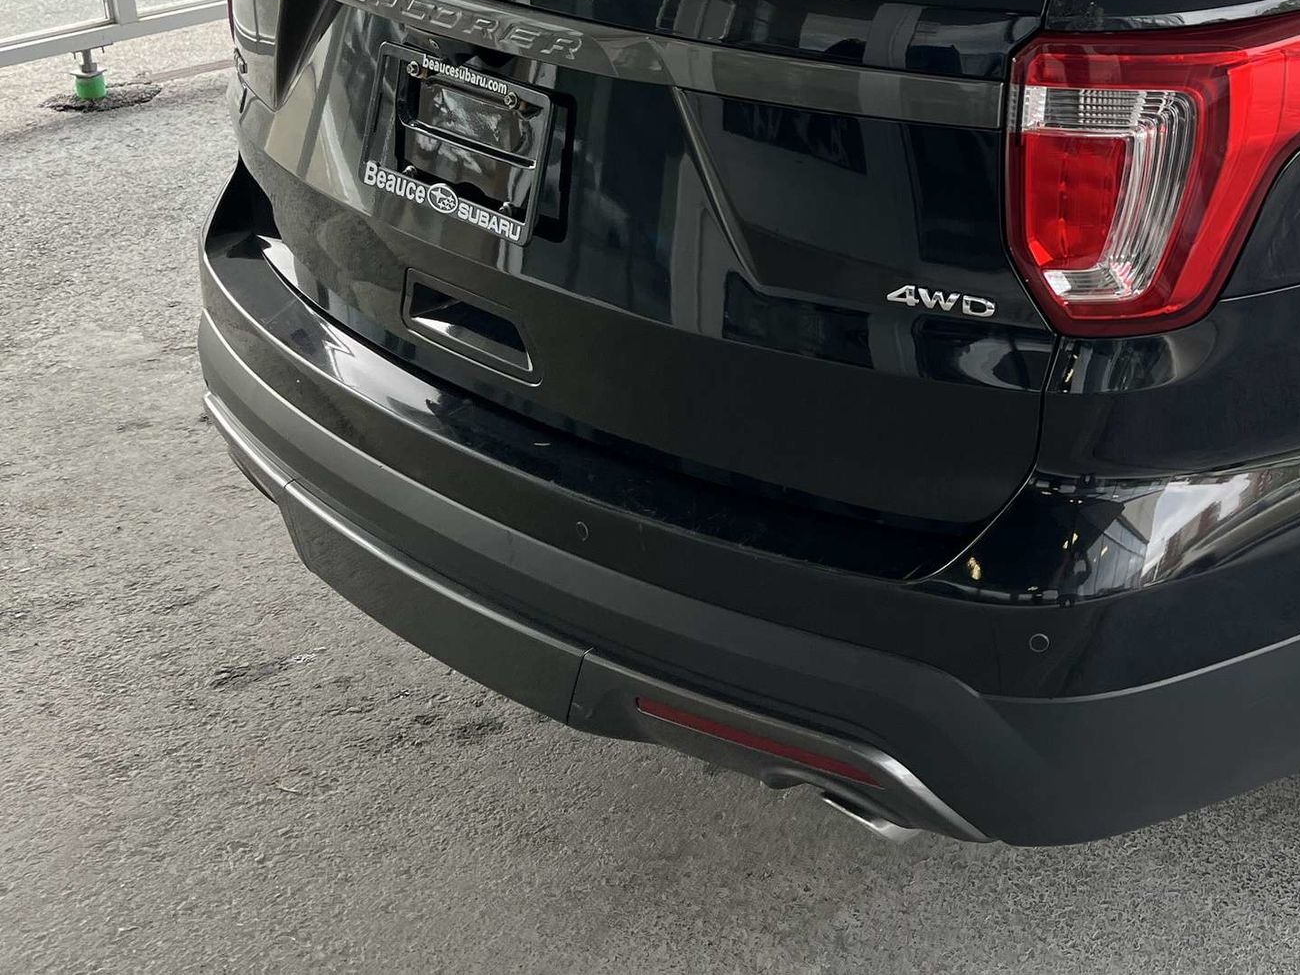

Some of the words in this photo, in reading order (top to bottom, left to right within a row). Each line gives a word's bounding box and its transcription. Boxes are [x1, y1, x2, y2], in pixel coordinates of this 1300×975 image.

[422, 54, 508, 95] beaucesubaru.com
[363, 160, 426, 204] Beauce
[457, 202, 521, 242] SUBARU
[886, 284, 996, 317] 4WD
